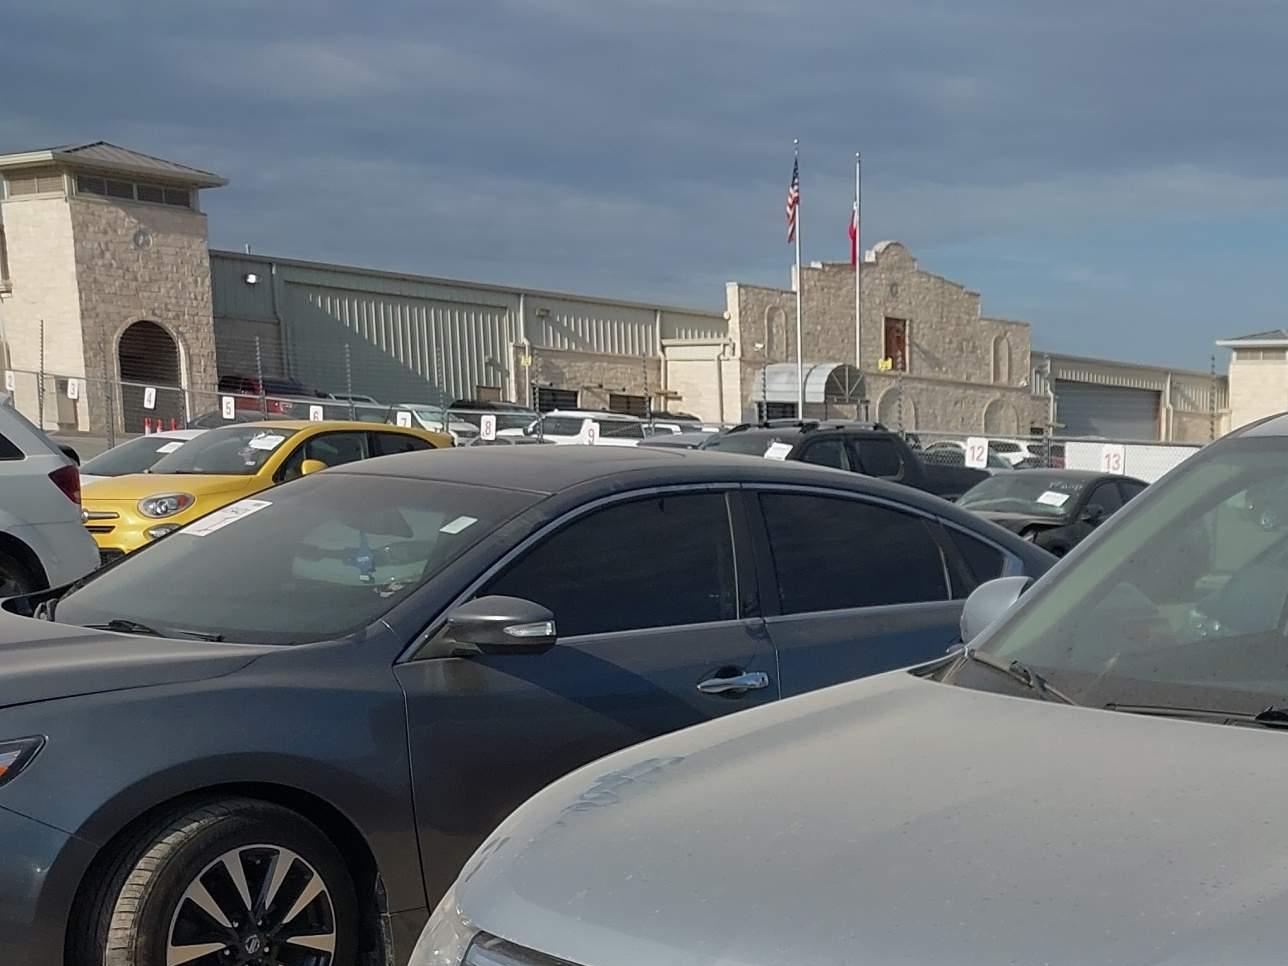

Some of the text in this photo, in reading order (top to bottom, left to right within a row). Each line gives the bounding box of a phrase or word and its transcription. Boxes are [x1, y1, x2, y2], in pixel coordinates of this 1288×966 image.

[225, 401, 232, 416] 5
[485, 420, 492, 436] 8
[588, 428, 595, 445] 9
[969, 445, 985, 463] 12
[1103, 453, 1121, 471] 13
